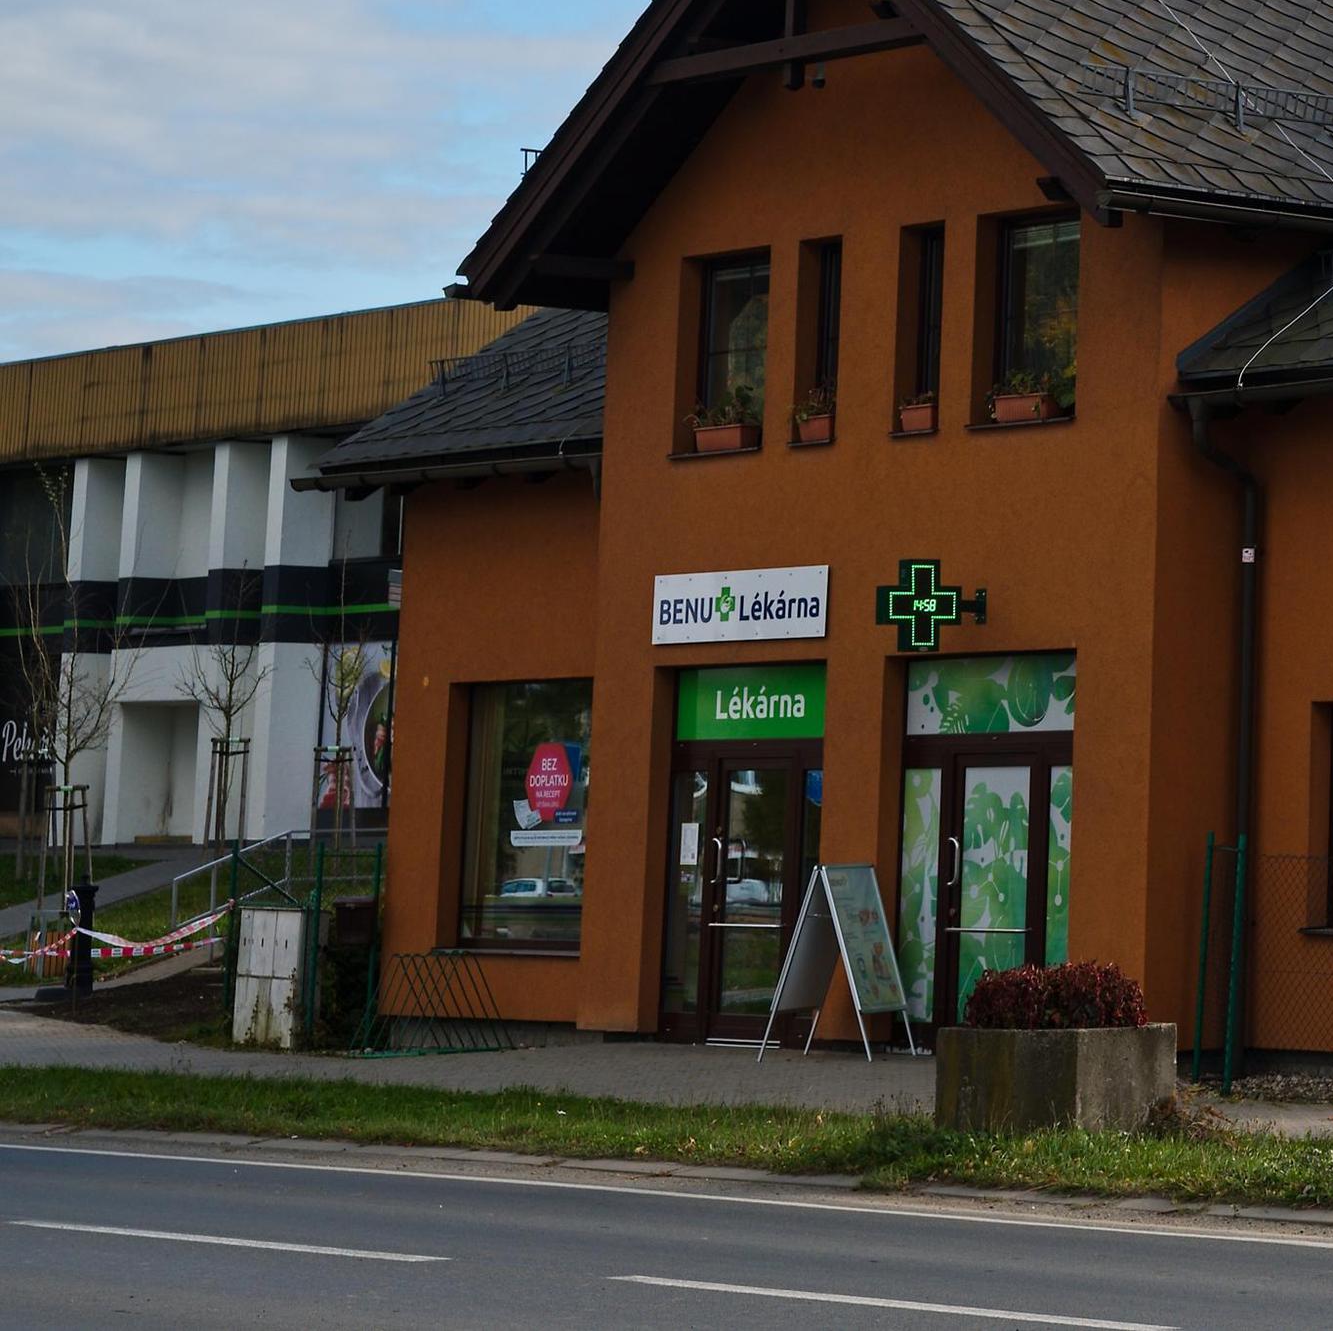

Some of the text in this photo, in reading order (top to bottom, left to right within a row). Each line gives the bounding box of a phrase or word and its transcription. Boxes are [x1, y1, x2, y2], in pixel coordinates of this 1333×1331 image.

[659, 589, 820, 626] BENU Lékárna
[912, 598, 937, 612] 14:58
[715, 685, 806, 720] Lékárna
[541, 757, 558, 771] BEZ
[529, 774, 569, 787] DOPLATKU
